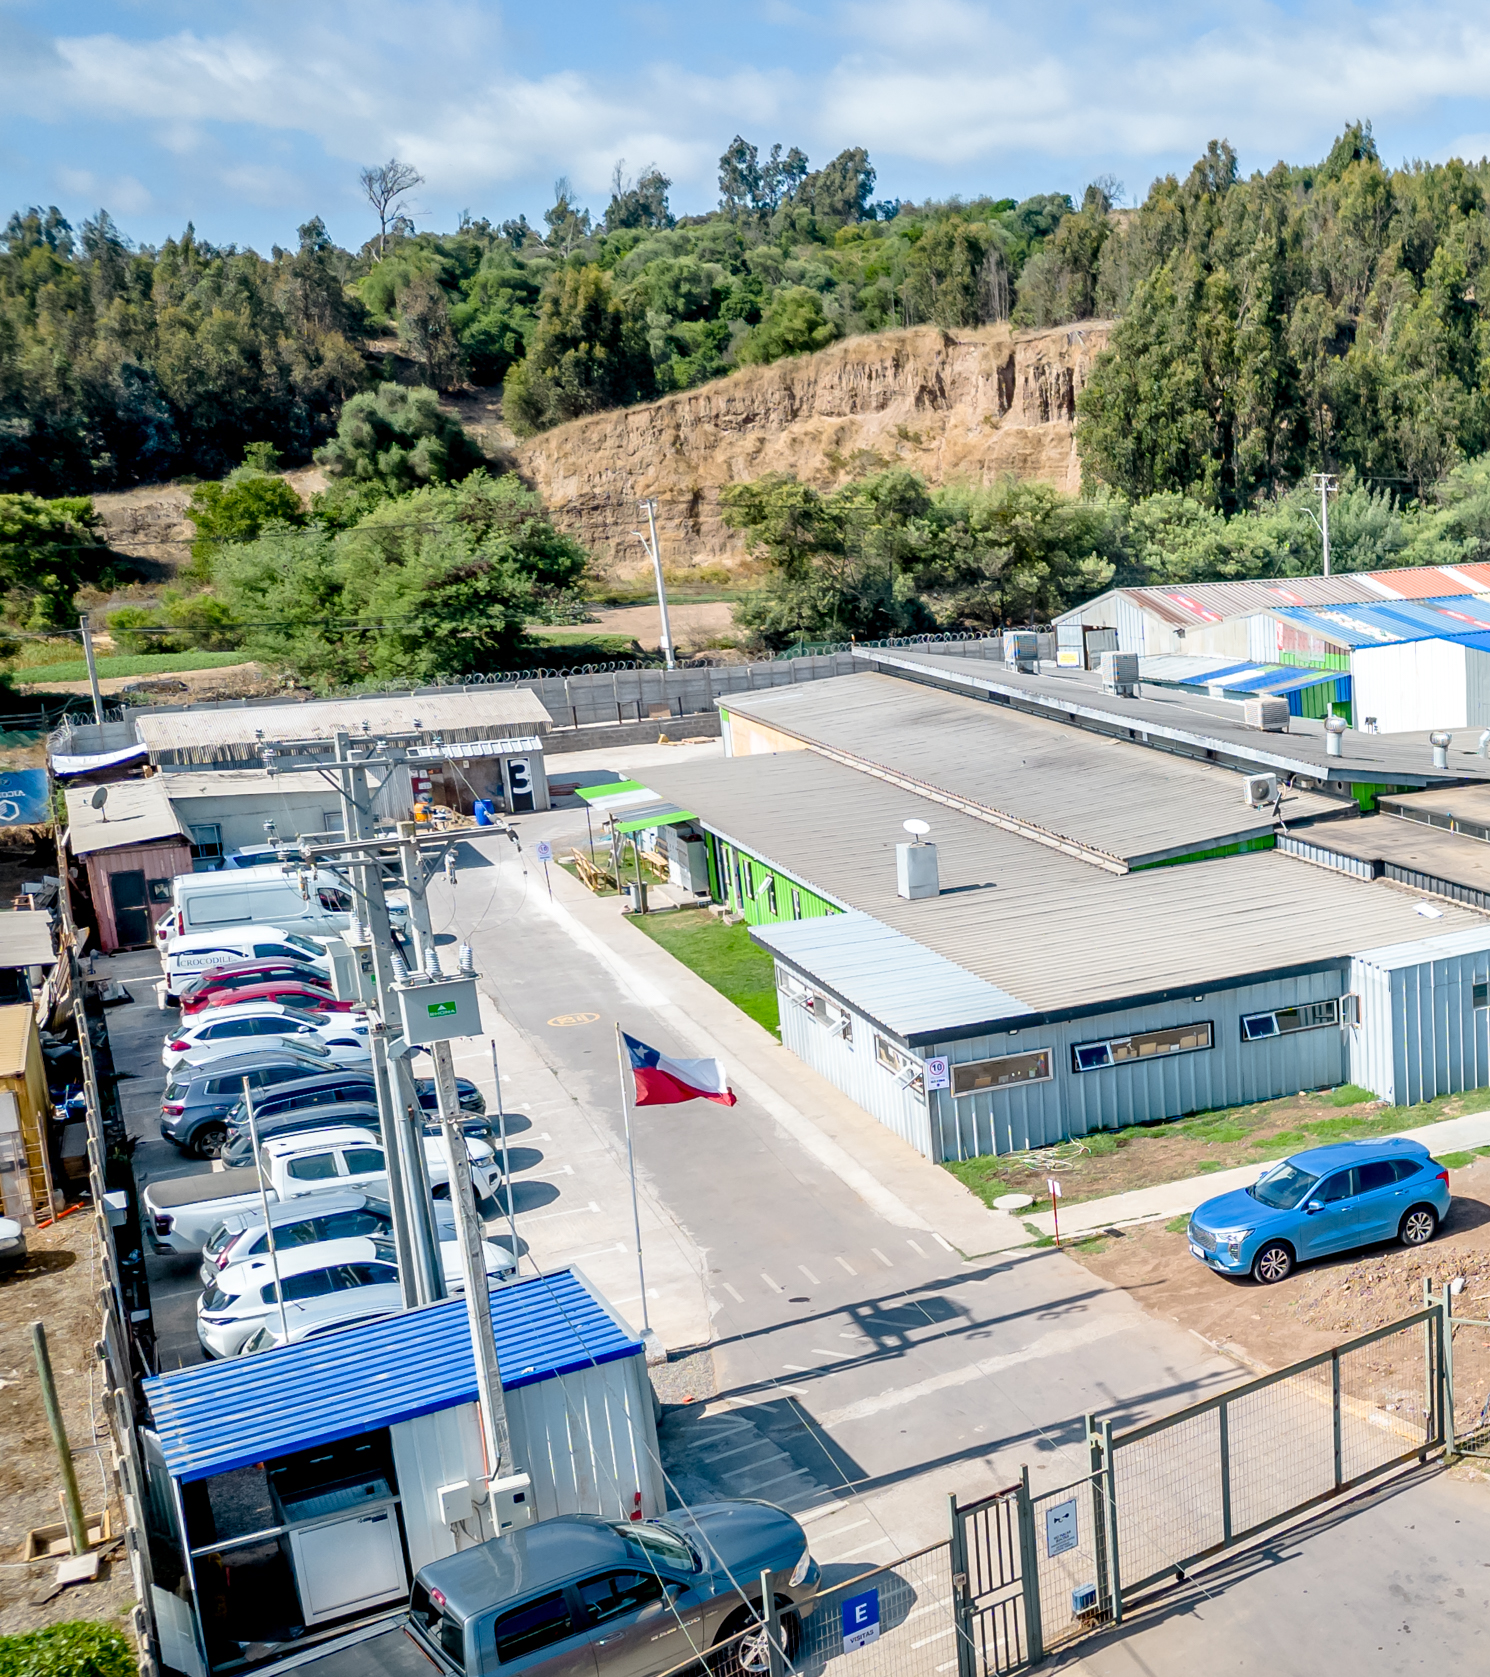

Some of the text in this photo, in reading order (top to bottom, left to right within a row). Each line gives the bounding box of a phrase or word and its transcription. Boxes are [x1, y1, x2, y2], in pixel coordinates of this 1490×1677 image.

[180, 956, 234, 968] CROCODILE
[932, 1063, 943, 1072] 10
[855, 1602, 868, 1624] E
[849, 1629, 875, 1644] VISITAS
